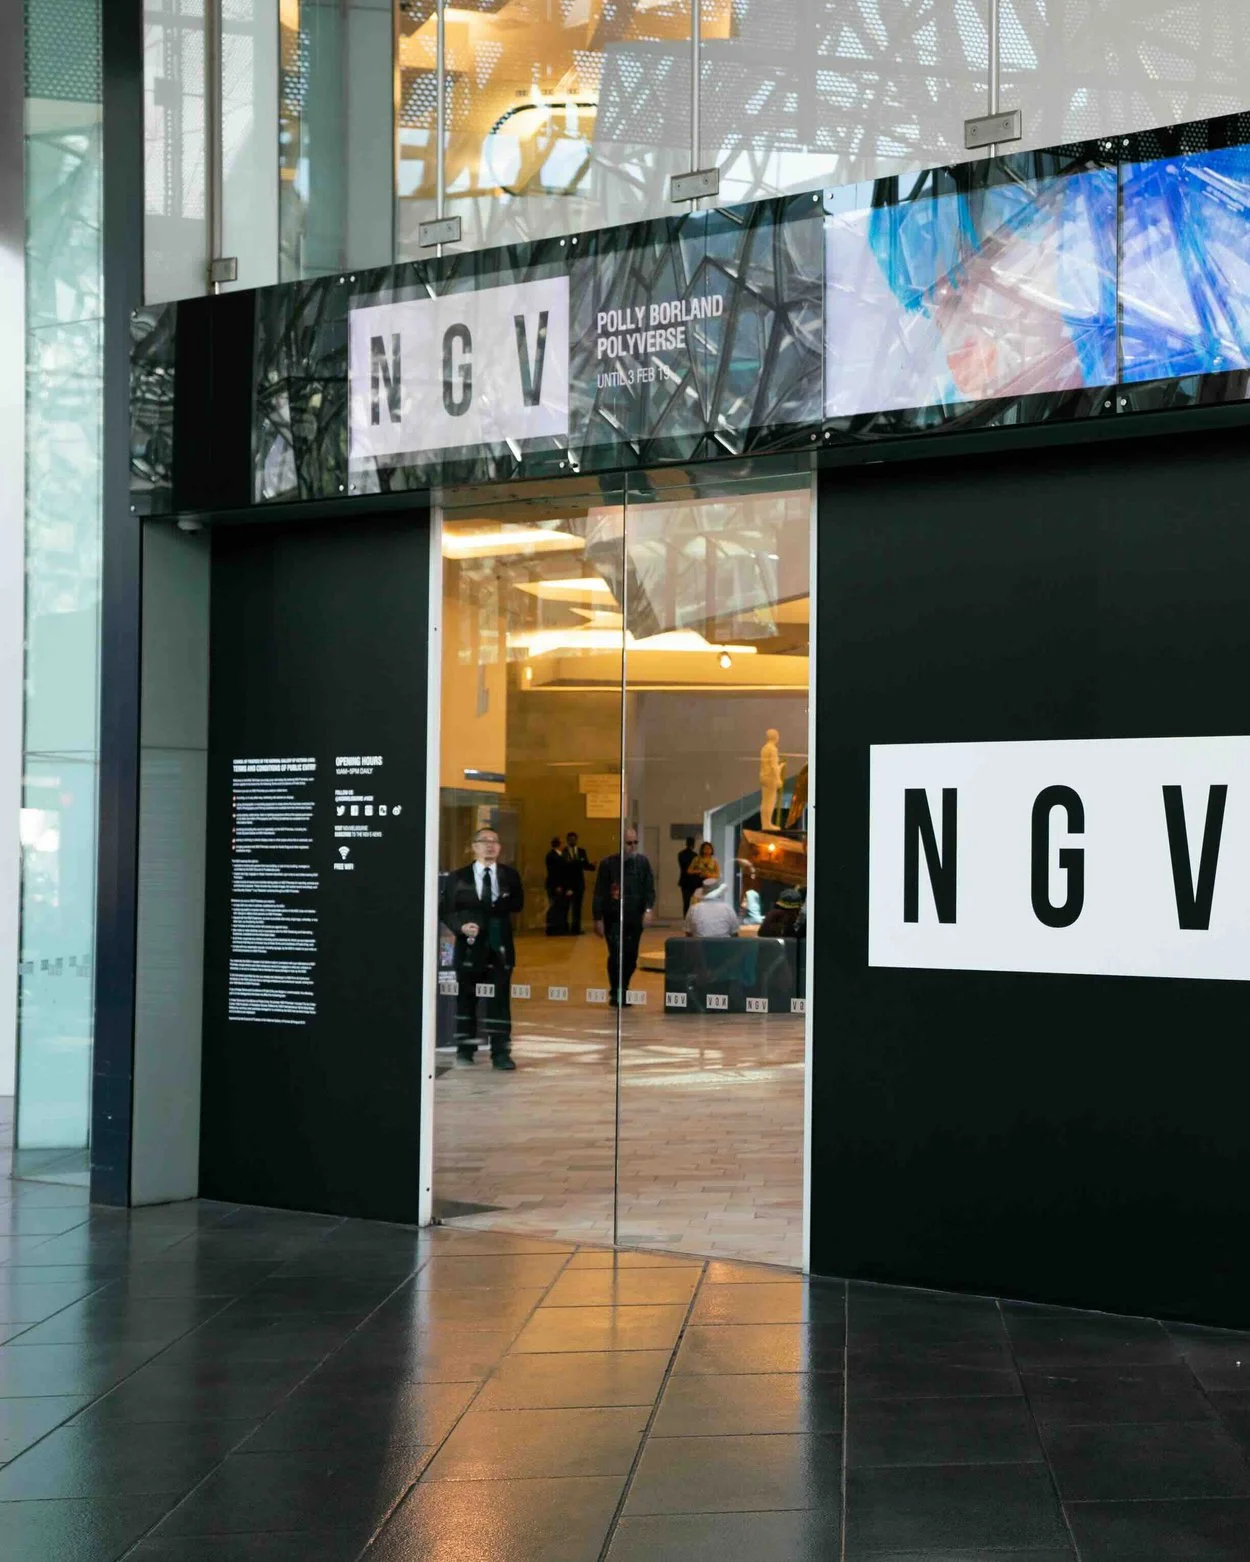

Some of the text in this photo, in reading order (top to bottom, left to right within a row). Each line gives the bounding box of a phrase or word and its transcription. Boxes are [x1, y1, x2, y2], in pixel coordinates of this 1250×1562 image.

[597, 295, 723, 334] POLLY BORLAND
[597, 326, 686, 359] POLYVERSE
[597, 365, 671, 388] UNTIL 3 FEB 19
[361, 756, 383, 766] HOURS
